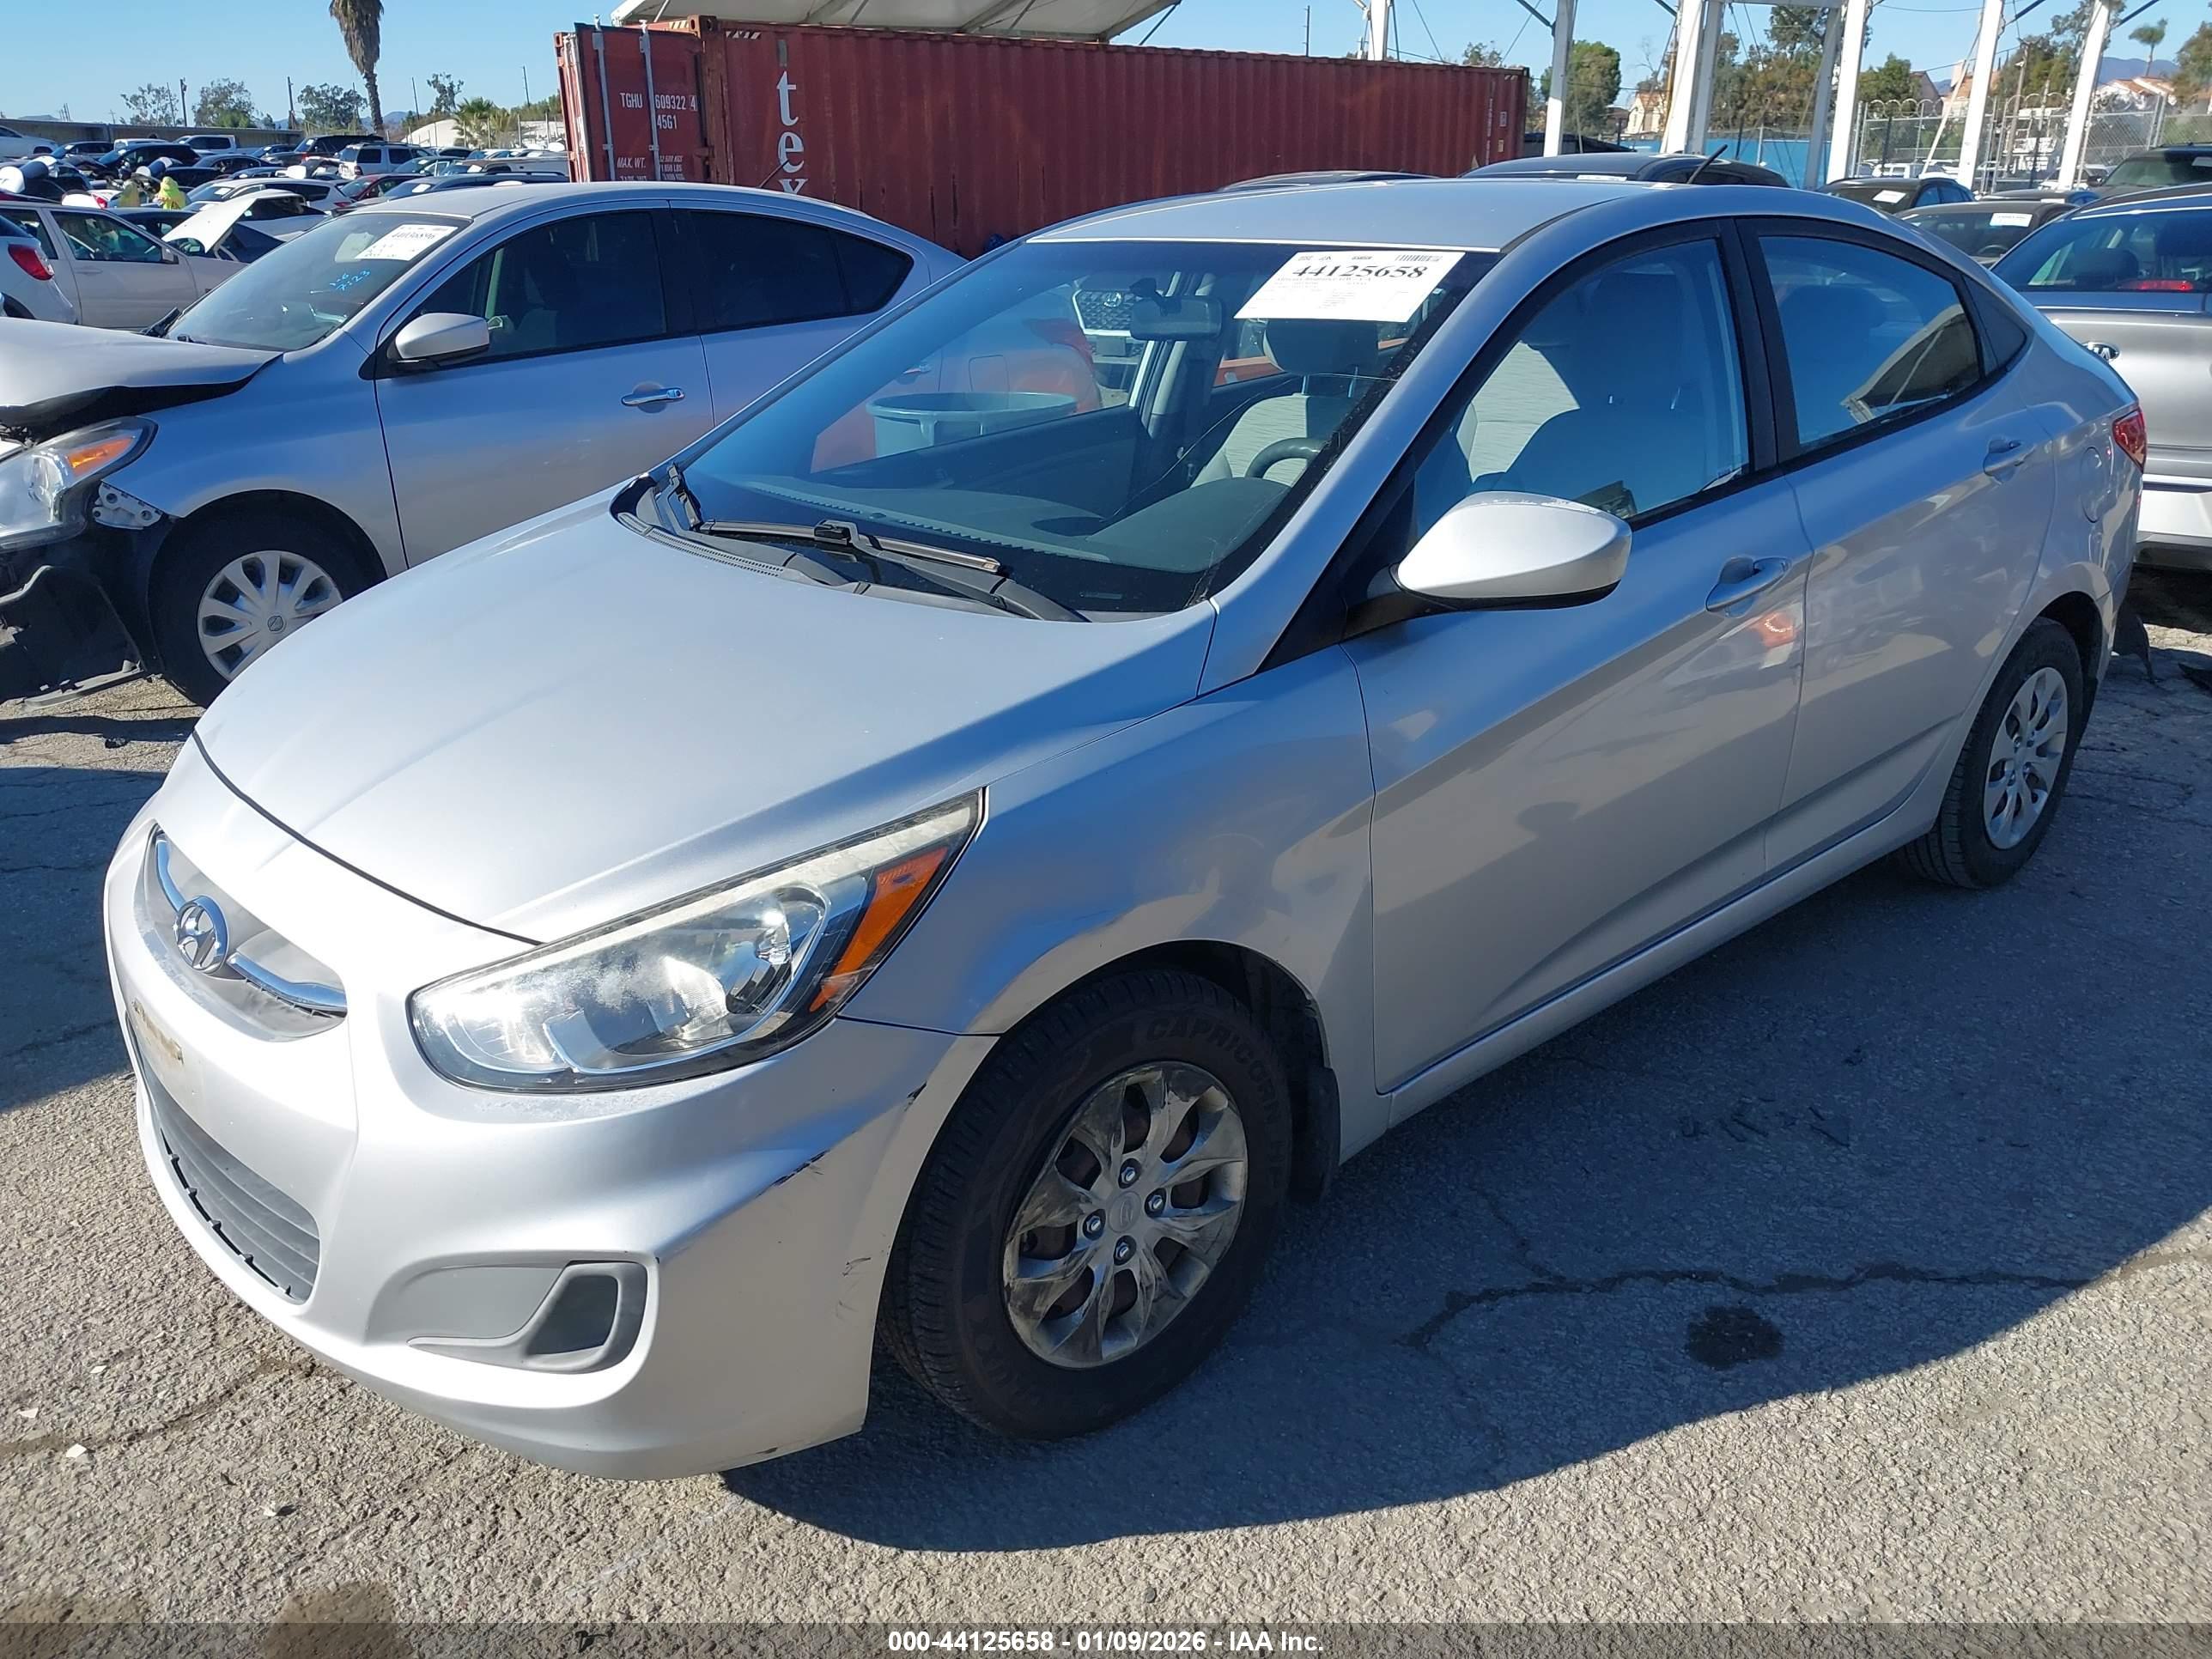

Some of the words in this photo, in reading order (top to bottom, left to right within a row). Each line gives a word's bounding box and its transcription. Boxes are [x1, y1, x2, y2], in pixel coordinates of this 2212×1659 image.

[619, 92, 643, 108] TGHU
[654, 94, 687, 111] 609322
[657, 114, 678, 130] 45G1
[634, 158, 647, 168] WT.
[1291, 264, 1429, 278] 44125658
